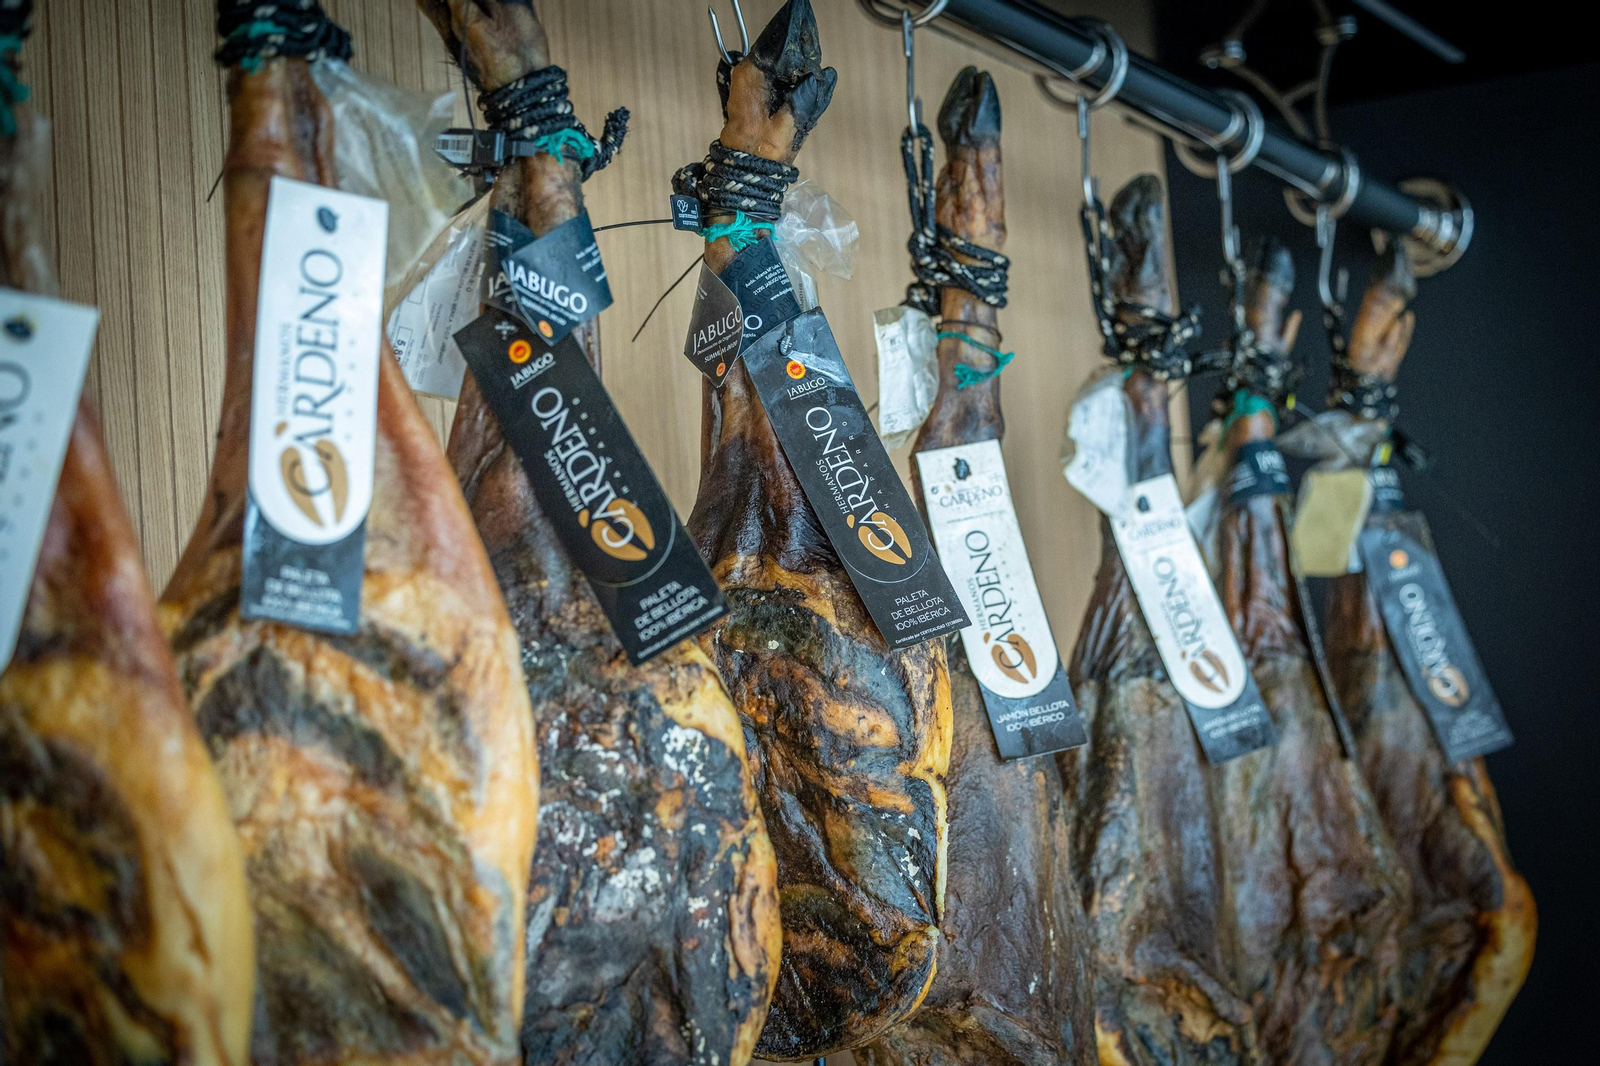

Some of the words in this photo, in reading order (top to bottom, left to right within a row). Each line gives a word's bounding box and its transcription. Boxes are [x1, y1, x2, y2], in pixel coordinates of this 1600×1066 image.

[508, 259, 588, 314] JABUGO
[693, 305, 742, 356] JABUGO
[510, 352, 554, 387] JABUGO
[786, 377, 826, 398] JABUGO
[544, 449, 584, 513] HERMANOS
[815, 459, 850, 515] HERMANOS
[634, 612, 653, 630] DE
[650, 585, 701, 621] BELLOTA
[639, 581, 682, 611] PALETA
[890, 610, 905, 620] DE
[904, 596, 944, 616] BELLOTA
[894, 589, 929, 606] PALETA
[894, 618, 918, 632] 100%
[917, 606, 951, 624] IBÉRICA
[996, 707, 1029, 724] JAMÓN
[1028, 699, 1070, 716] BELLOTA
[1027, 711, 1065, 728] IBÉRICO
